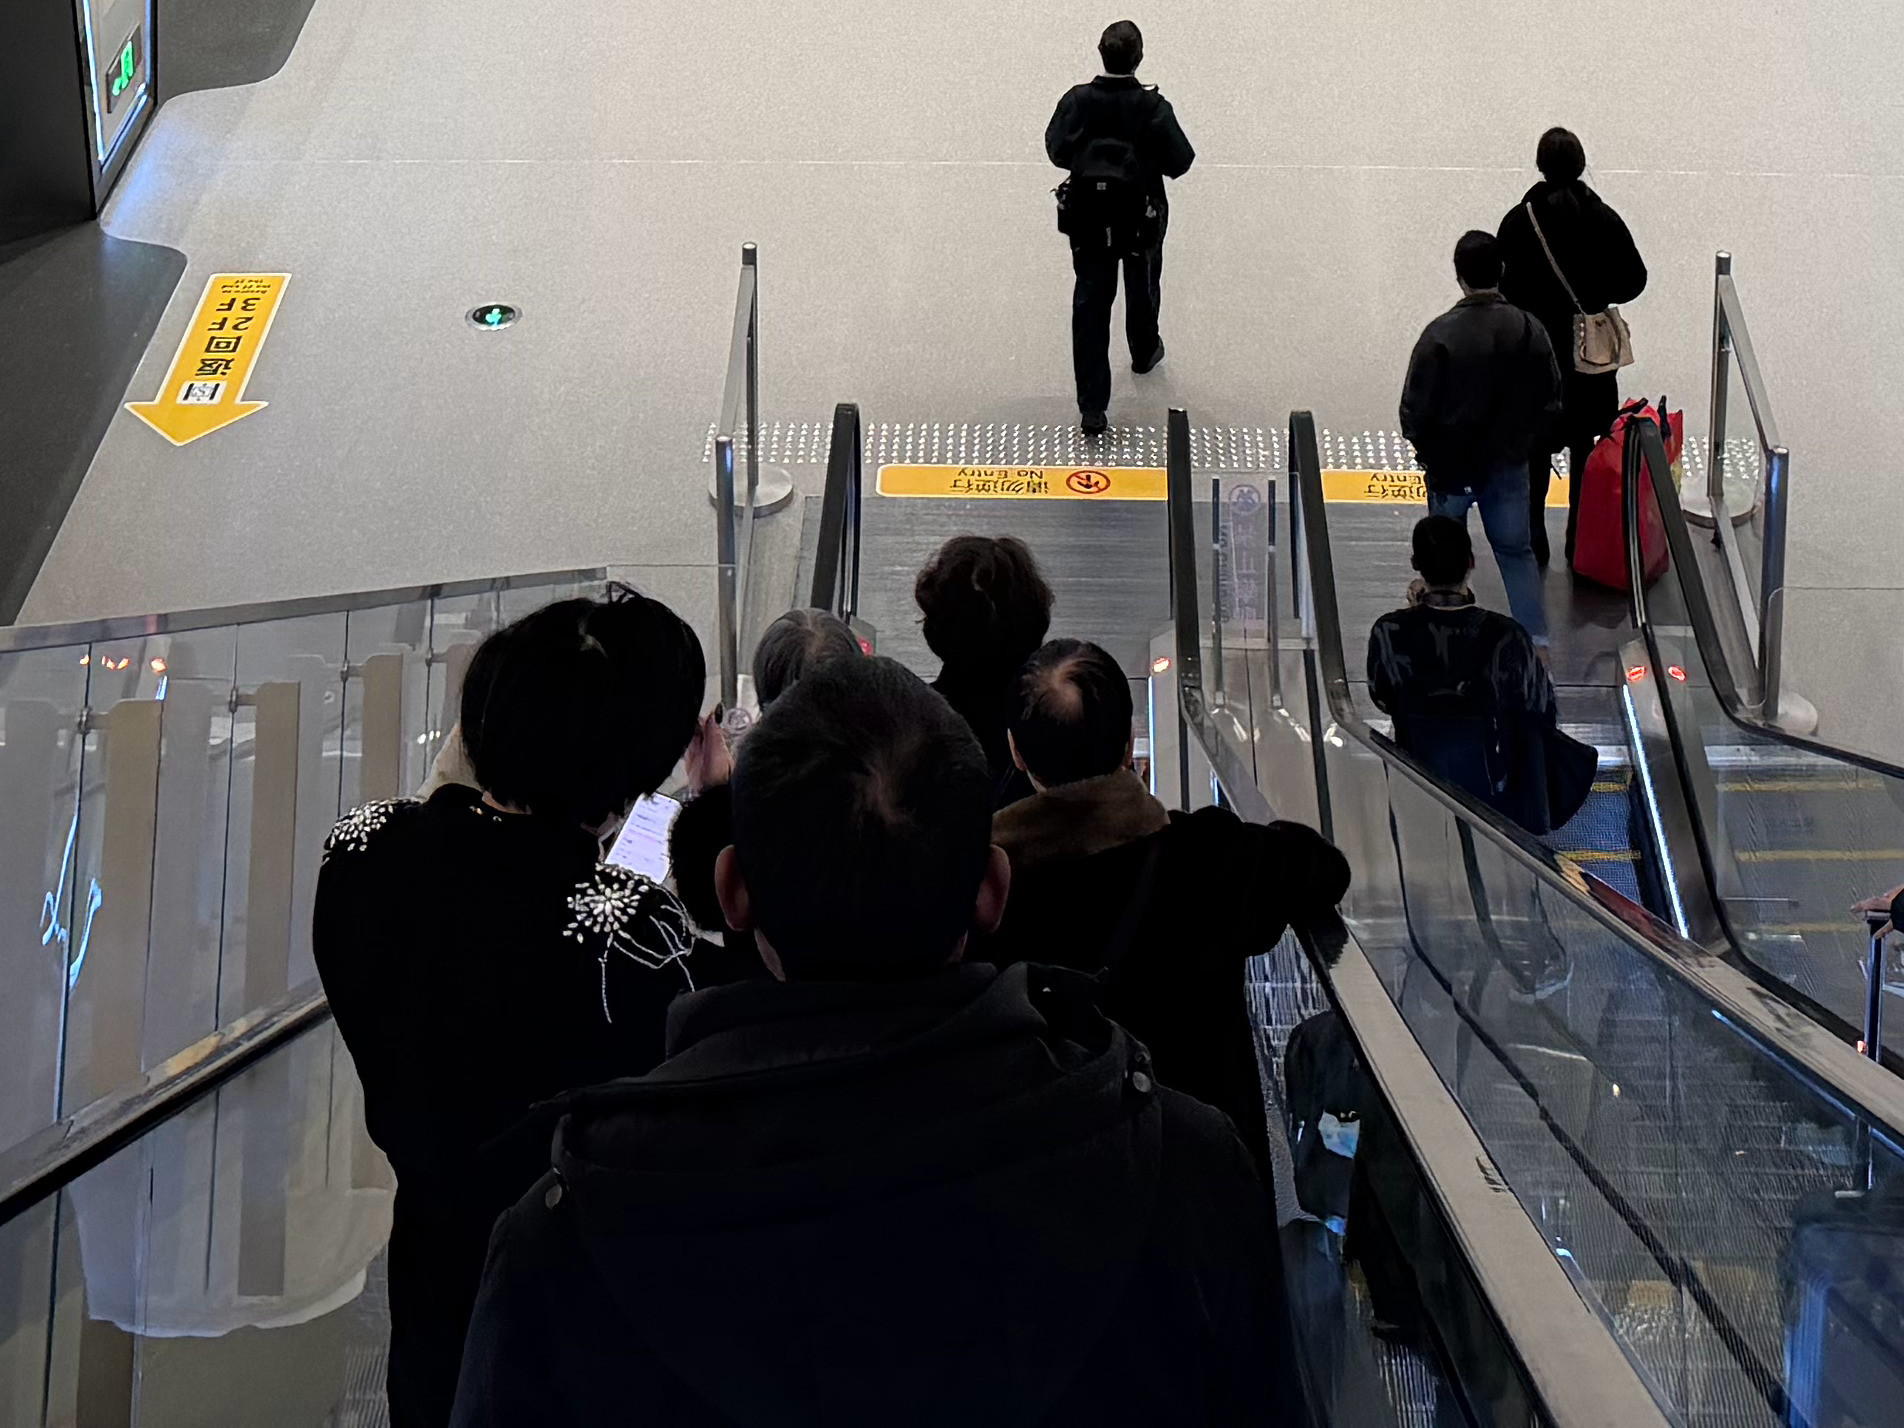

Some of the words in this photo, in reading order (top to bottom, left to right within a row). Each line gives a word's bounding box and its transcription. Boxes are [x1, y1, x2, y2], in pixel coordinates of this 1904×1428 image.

[215, 297, 261, 312] 3F
[206, 316, 255, 332] 2F
[957, 468, 1009, 479] Entry
[1017, 470, 1043, 480] No
